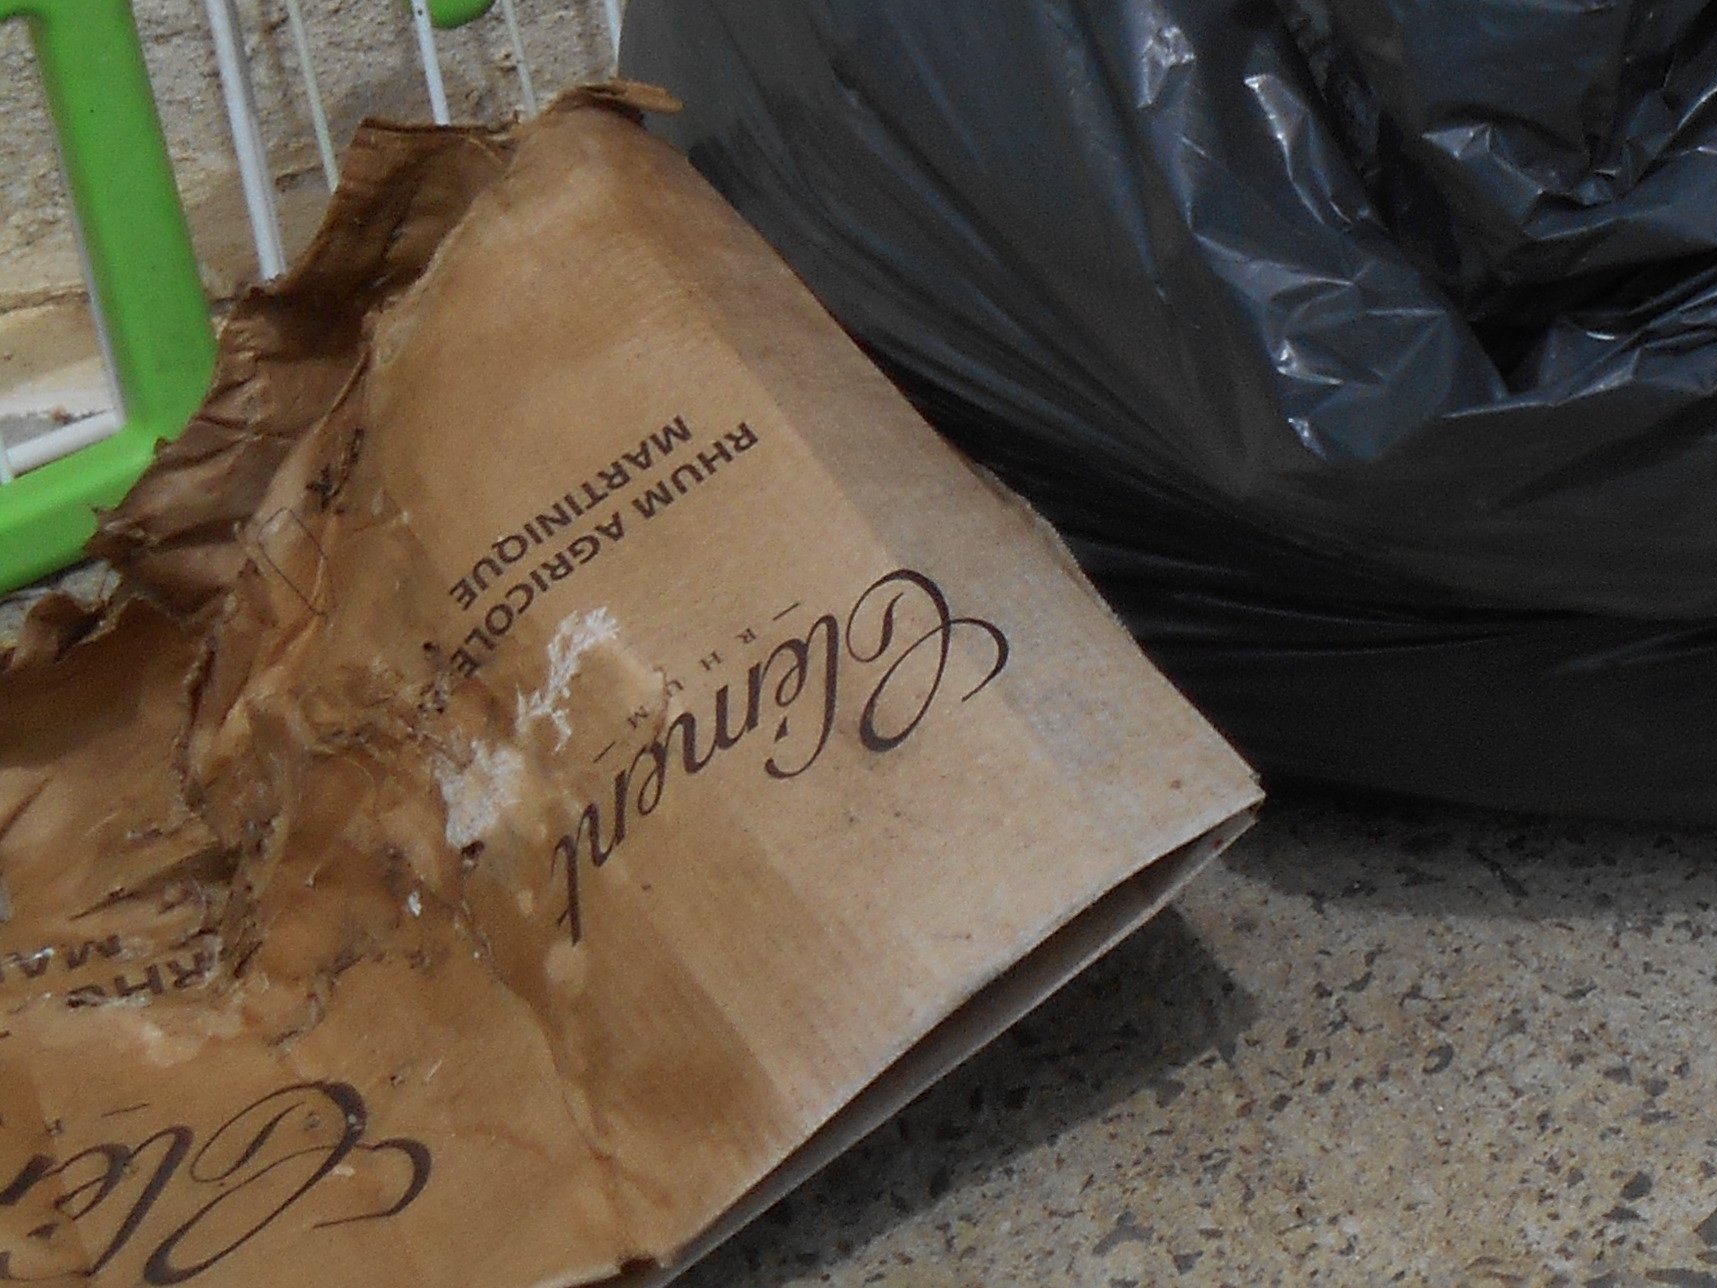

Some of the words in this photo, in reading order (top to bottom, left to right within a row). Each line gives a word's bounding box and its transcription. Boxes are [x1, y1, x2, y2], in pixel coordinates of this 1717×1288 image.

[447, 414, 693, 611] MARTINIQUE
[631, 419, 760, 522] RHUM
[449, 512, 624, 681] AGRICOLE
[550, 569, 1010, 947] Clément
